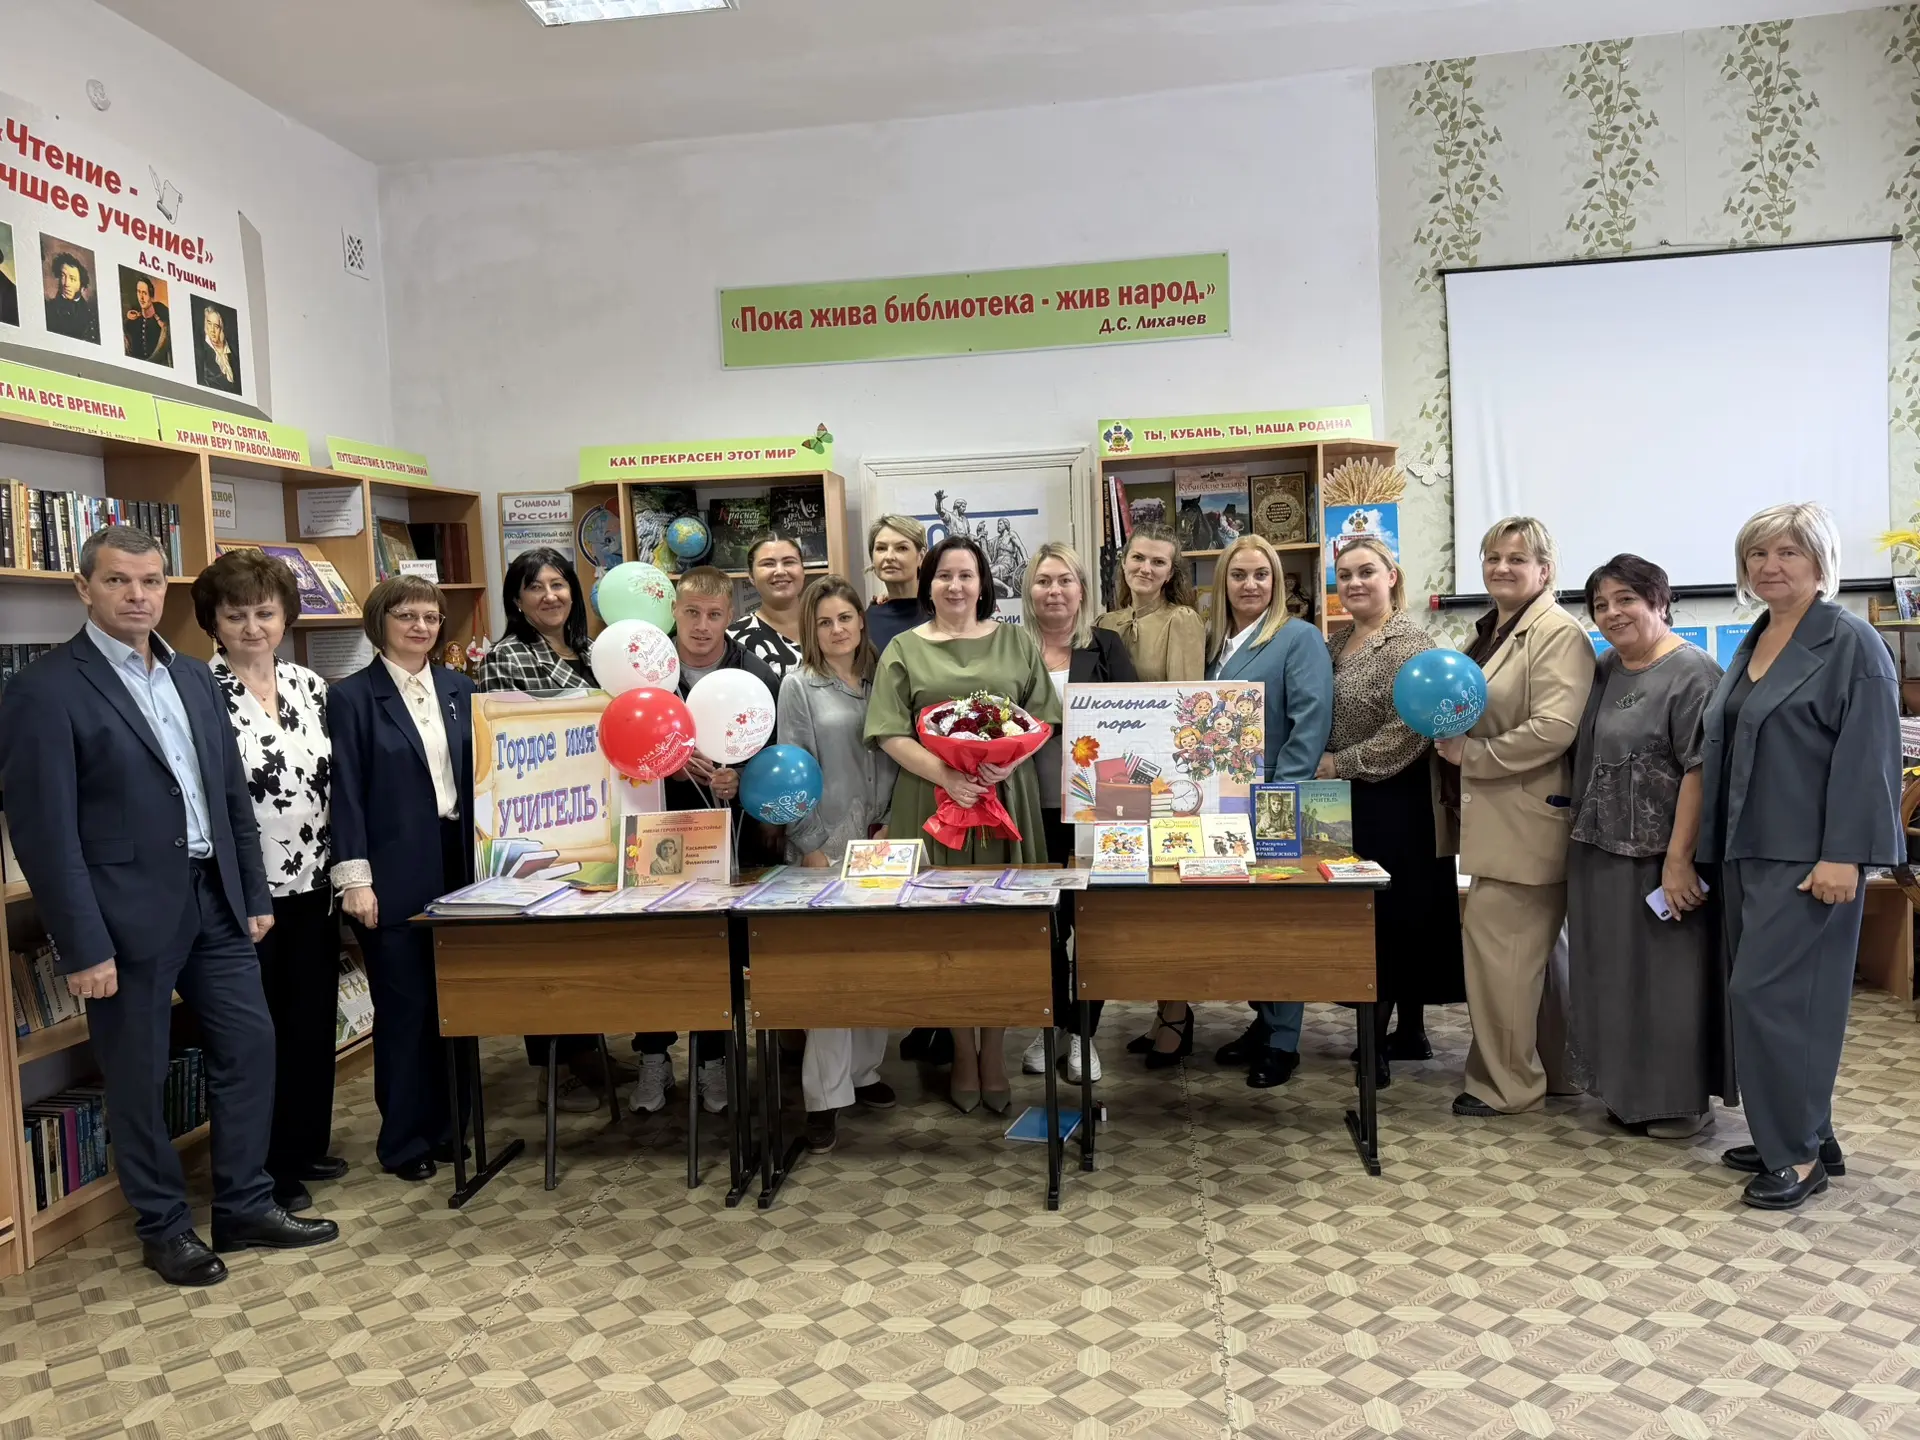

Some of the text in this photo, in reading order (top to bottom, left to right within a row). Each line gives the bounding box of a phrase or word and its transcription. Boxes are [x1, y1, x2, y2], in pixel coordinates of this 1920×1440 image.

[97, 201, 214, 266] учение!»
[139, 251, 217, 292] А.С. Пушкин
[731, 305, 802, 333] «Пока
[810, 301, 877, 328] жива
[884, 293, 1035, 323] библиотека
[1056, 286, 1110, 312] жив
[1118, 279, 1216, 307] народ.»
[1099, 311, 1207, 334] Д.С. Лихачев
[18, 385, 37, 403] НА
[39, 390, 65, 409] ВСЕ
[67, 396, 126, 420] ВРЕМЕНА
[212, 420, 271, 444] РУСЬ СВЯТАЯ,
[1144, 417, 1353, 443] ТЫ, КУБАНЬ, ТЫ, НАША РОДИНА
[176, 430, 301, 463] ХРАНИ ВЕРУ ПРАВОСЛАВНУЮ!
[609, 448, 797, 467] КАК ПРЕКРАСЕН ЭТОТ МИР
[336, 451, 380, 468] ПУТЕШЕСТВИЕ
[386, 461, 406, 473] СТРАНУ
[406, 464, 428, 476] ЗНАНИЙ
[508, 511, 568, 521] России
[514, 499, 561, 509] Символы
[1070, 695, 1173, 711] Школьная
[1097, 718, 1146, 734] пора
[496, 731, 556, 779] Гордое
